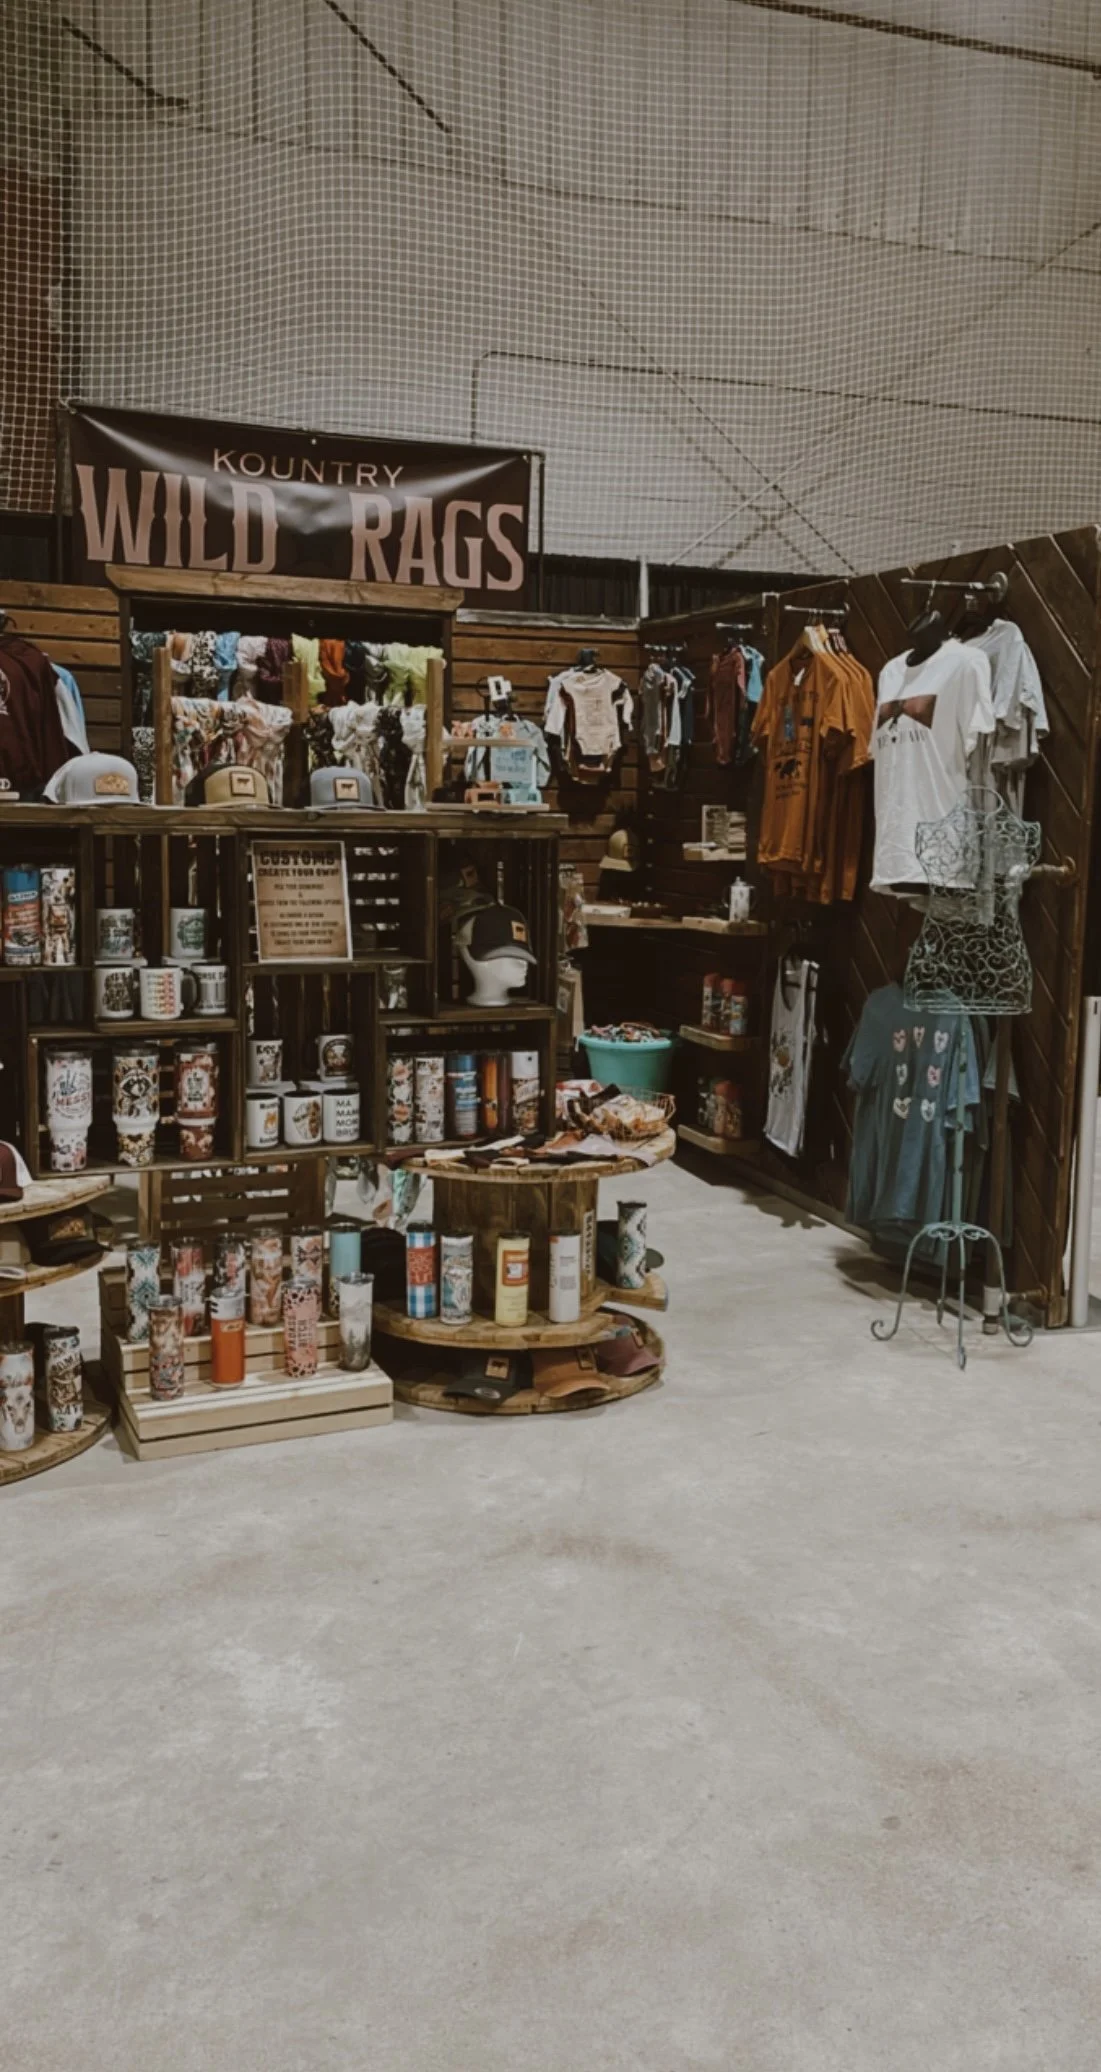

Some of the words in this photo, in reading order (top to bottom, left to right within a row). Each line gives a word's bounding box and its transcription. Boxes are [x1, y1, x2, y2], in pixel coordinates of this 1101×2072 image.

[213, 448, 404, 488] KOUNTRY
[75, 464, 279, 574] WILD
[348, 491, 525, 592] RAGS
[257, 868, 291, 877] CREATE
[292, 868, 314, 877] YOUR
[260, 850, 335, 866] CUSTOMS
[297, 1319, 308, 1348] BITCH
